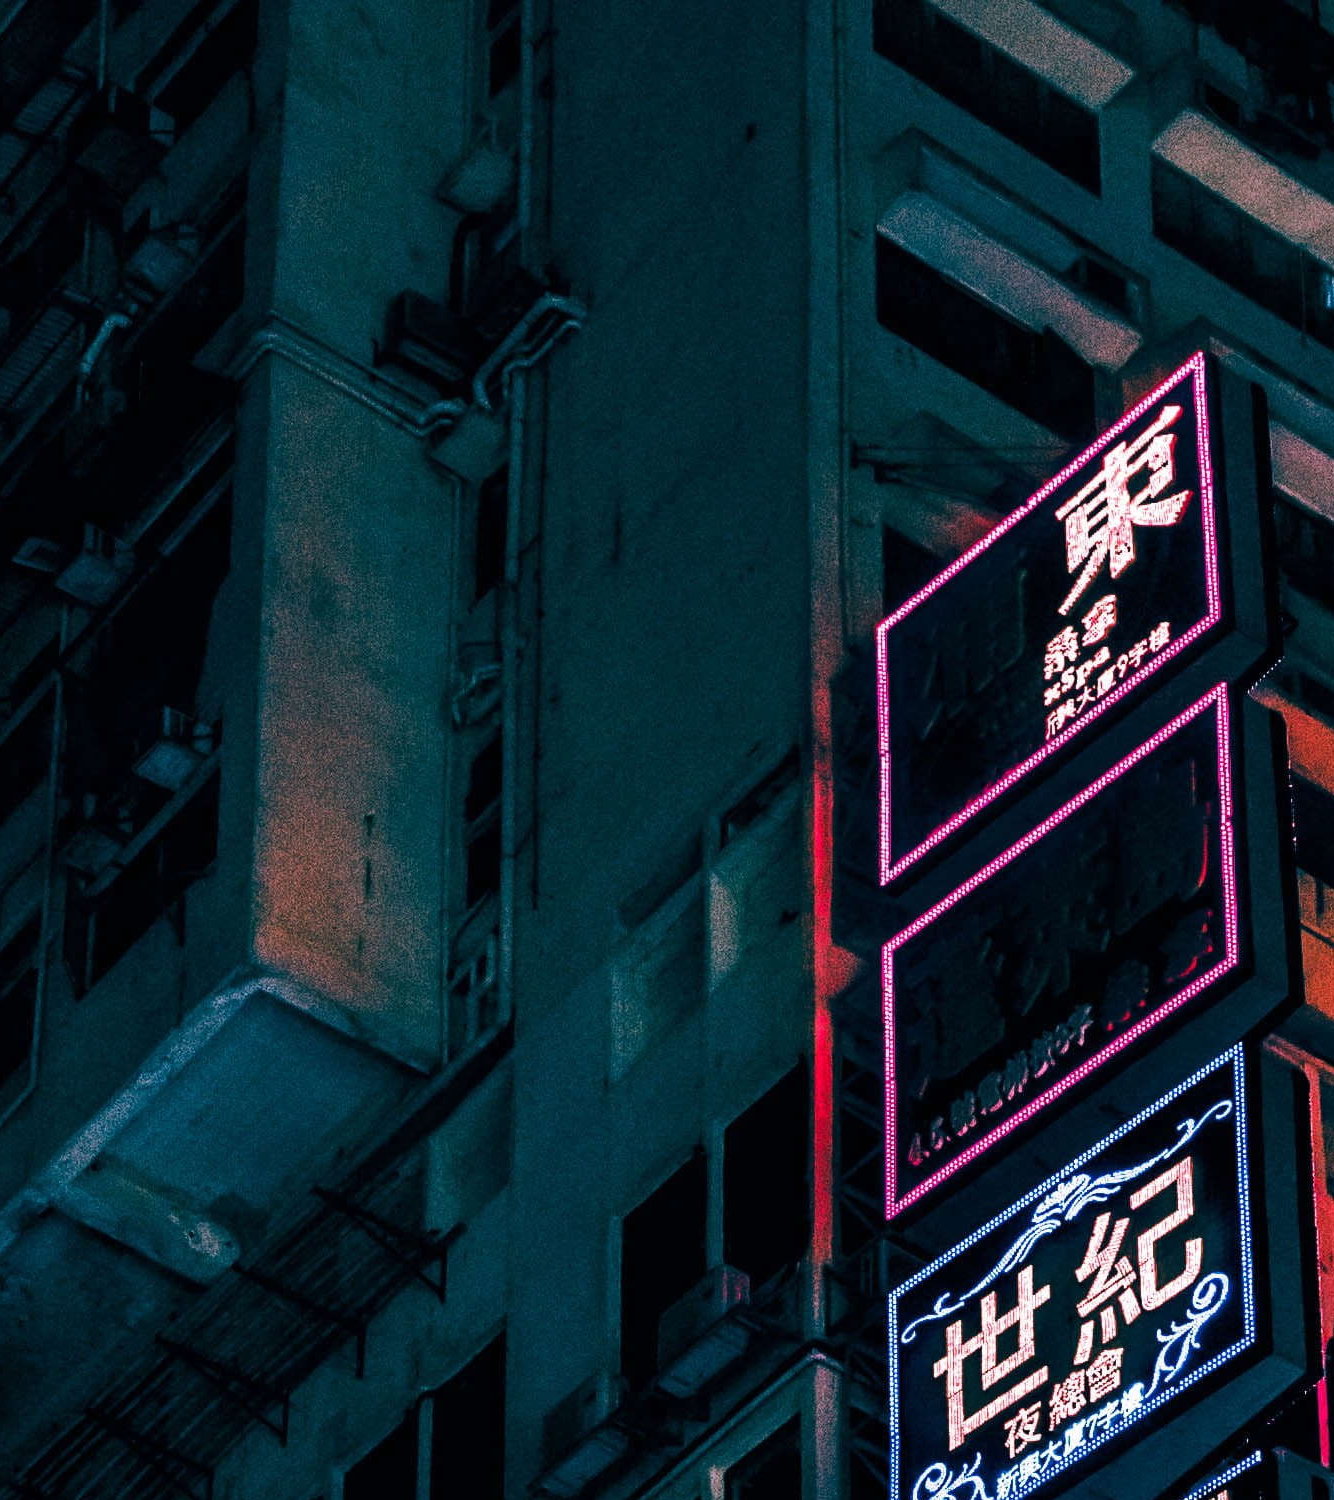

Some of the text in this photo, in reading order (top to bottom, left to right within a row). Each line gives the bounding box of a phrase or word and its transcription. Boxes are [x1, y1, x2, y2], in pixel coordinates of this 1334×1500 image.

[1055, 405, 1192, 615] 東
[933, 1156, 1203, 1452] 世紀
[1003, 1347, 1124, 1459] 夜總會
